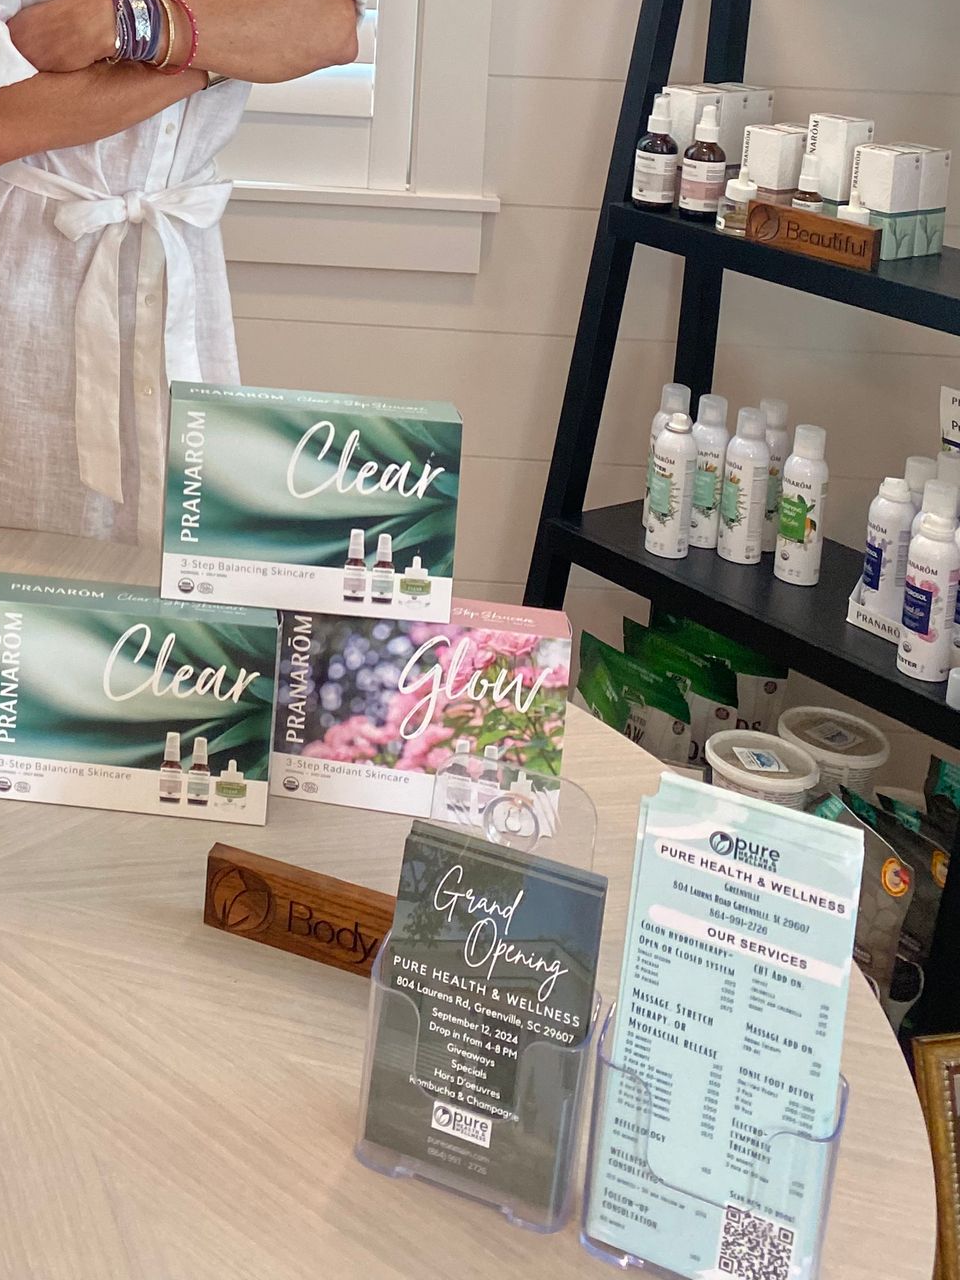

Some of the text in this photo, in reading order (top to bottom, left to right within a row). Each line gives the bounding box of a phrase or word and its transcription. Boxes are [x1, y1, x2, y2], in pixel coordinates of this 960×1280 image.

[786, 220, 866, 258] Beautiful
[180, 410, 206, 542] PRANARŌM
[287, 418, 446, 500] Clear
[218, 562, 268, 576] Balancing
[271, 567, 316, 579] Skincare
[10, 583, 104, 598] PRANARŌM
[102, 623, 260, 704] Clear
[284, 614, 314, 745] PRANARŌM
[398, 634, 553, 740] Glow
[34, 762, 84, 776] Balancing
[87, 767, 132, 780] Skincare
[323, 762, 362, 778] Radiant
[365, 770, 410, 784] Skincare
[734, 836, 780, 861] pure
[660, 844, 846, 914] PURE HEALTH & WELLNESS
[434, 865, 524, 936] Grand
[672, 880, 688, 892] 804
[782, 918, 810, 934] 29607
[287, 899, 378, 964] Body
[707, 927, 808, 970] OUR SERVICES
[464, 917, 569, 1002] Opening
[662, 944, 672, 954] OR
[706, 956, 735, 977] SYSTEM
[393, 955, 580, 1028] PURE HEALTH & WELLNESS
[396, 976, 575, 1044] 804 Laurens Rd, Greenville, SC 29607
[429, 1020, 518, 1060] Drop in from 4-8 PM
[432, 1007, 519, 1044] September 12, 2024
[674, 1020, 686, 1032] OR
[446, 1042, 496, 1068] Giveaways
[684, 1039, 718, 1060] RELEASE
[409, 1074, 456, 1099] Kombucha
[457, 1090, 464, 1102] &
[434, 1068, 501, 1100] Hors D'oeuvres
[450, 1059, 487, 1080] Specials
[764, 1074, 784, 1090] FOOT
[788, 1085, 814, 1102] DETOX
[452, 1110, 489, 1131] pure
